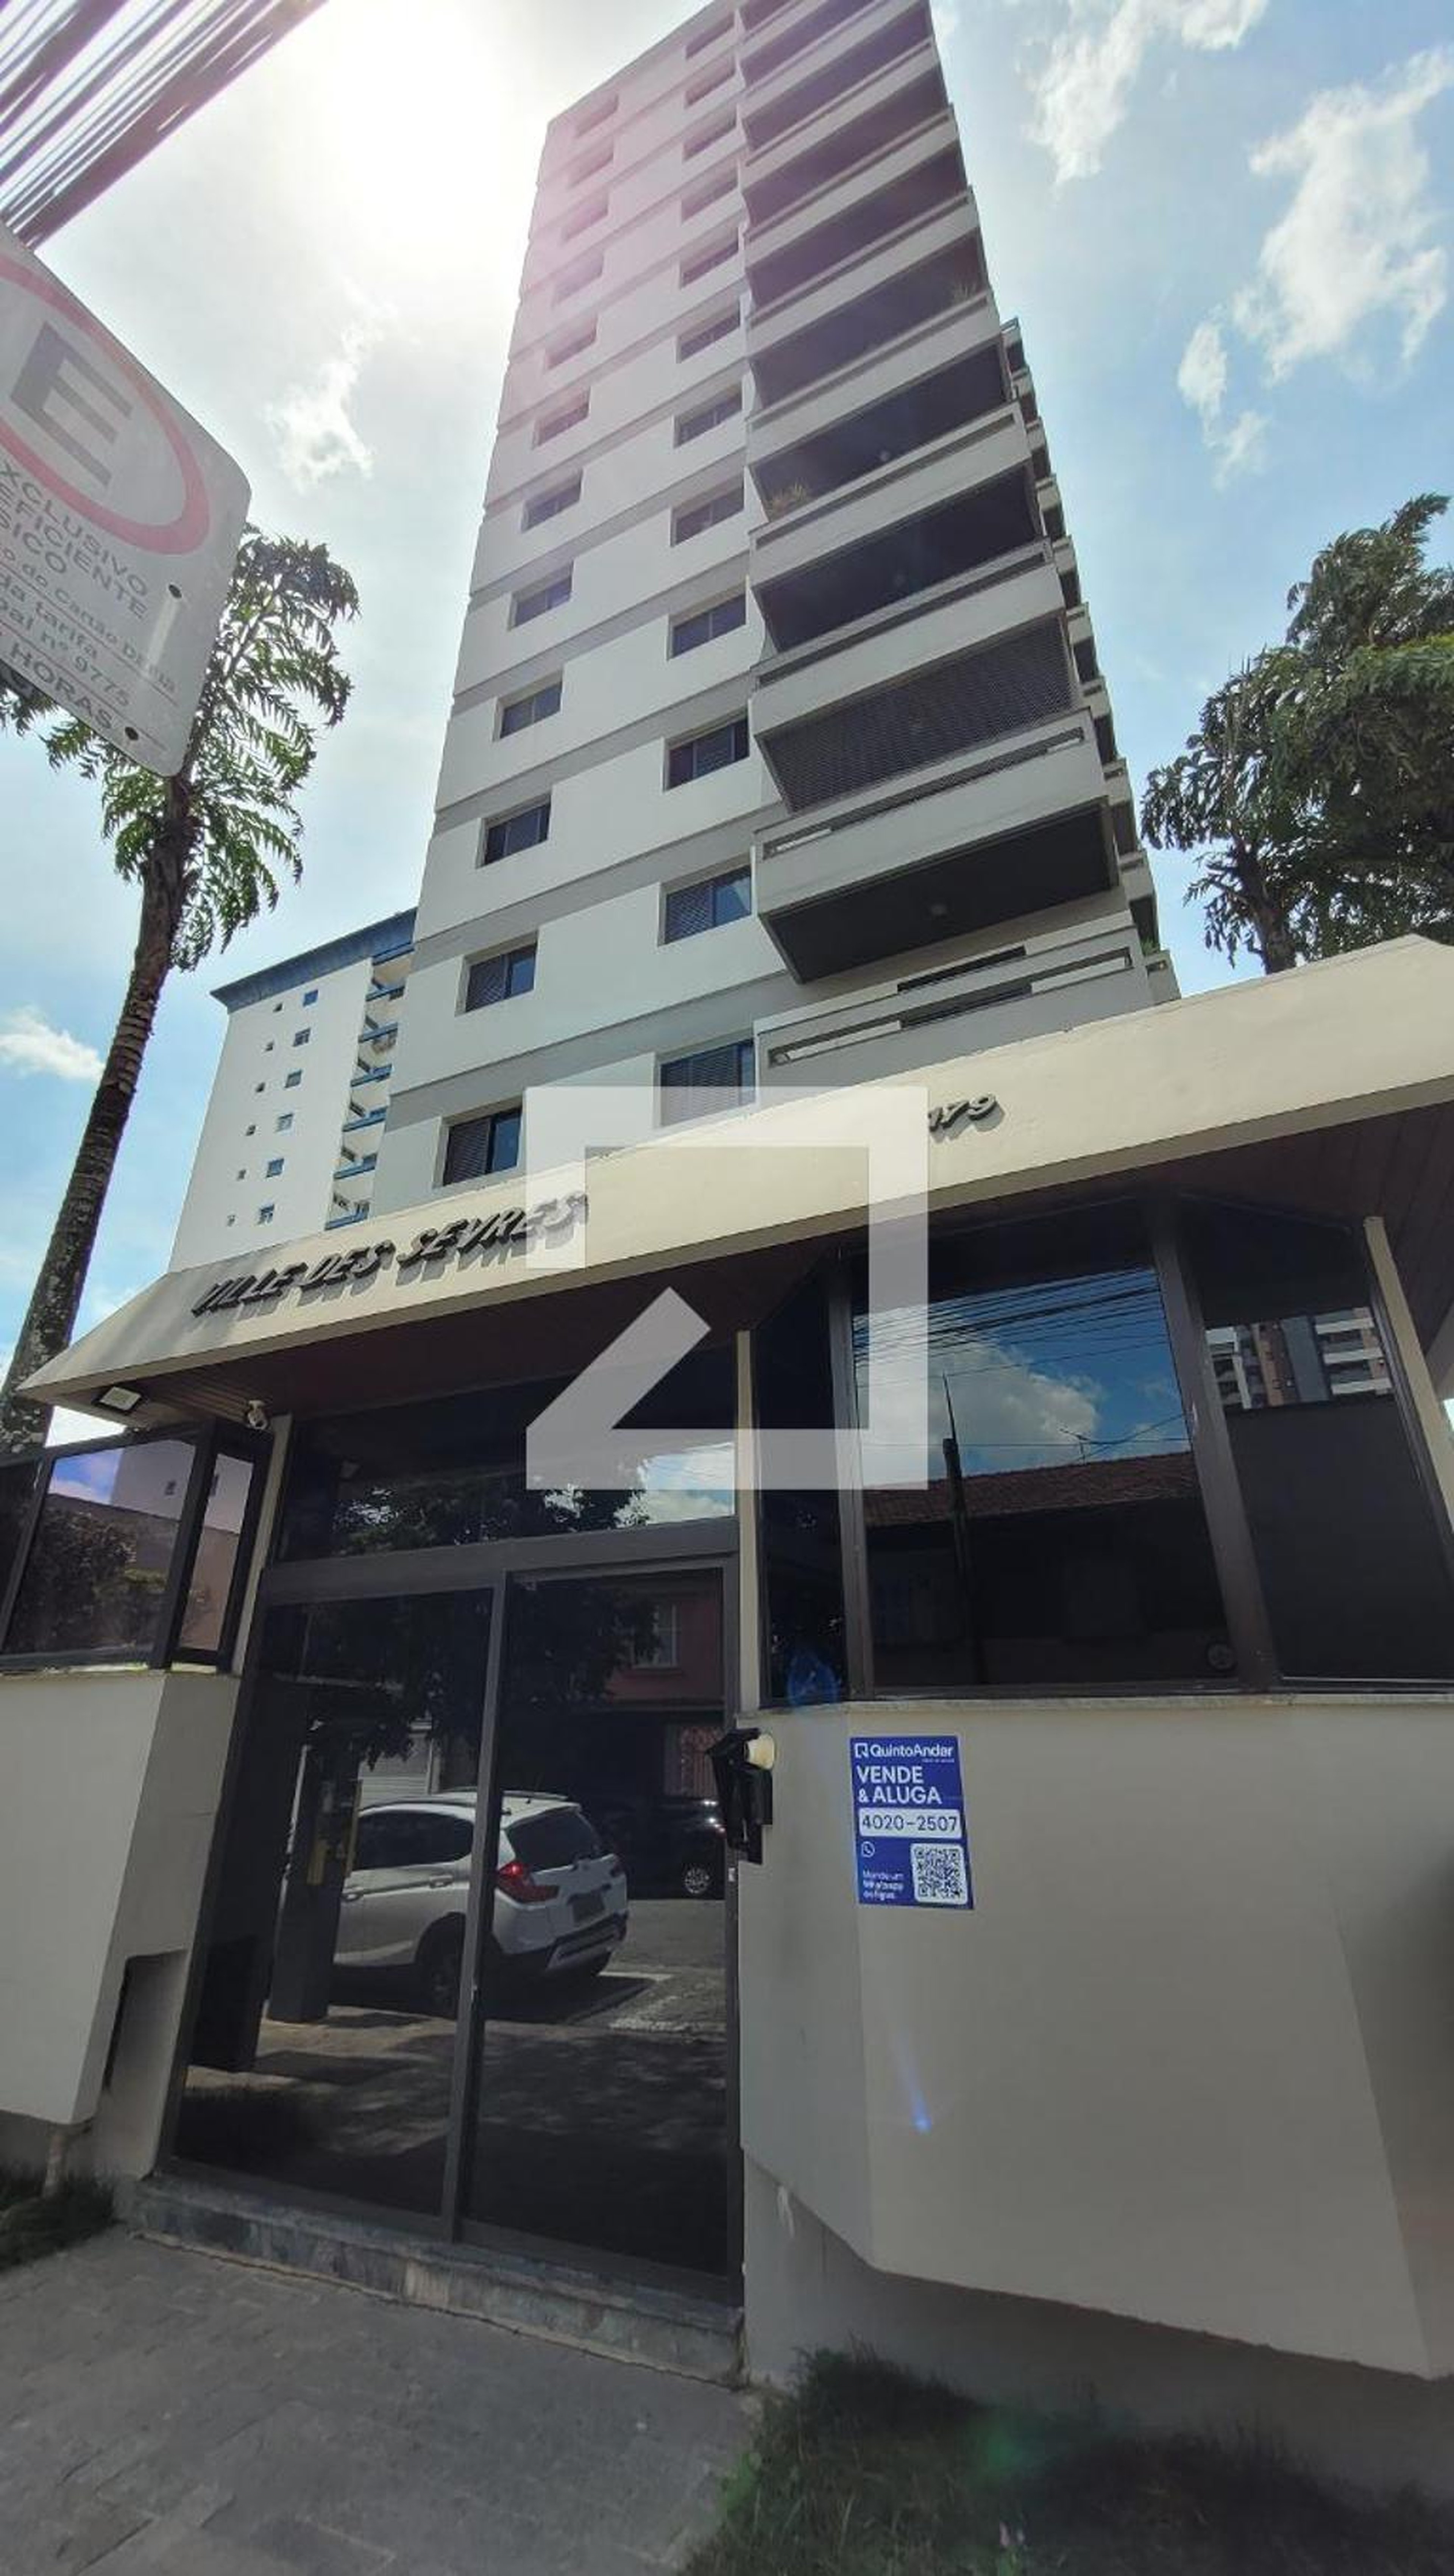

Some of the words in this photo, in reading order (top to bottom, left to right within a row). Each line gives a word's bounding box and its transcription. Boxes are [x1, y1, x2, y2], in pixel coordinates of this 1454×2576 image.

[11, 321, 134, 487] E
[0, 458, 147, 596] XCLUSIVO
[0, 507, 67, 573] SICO
[0, 481, 148, 619] EFICIENTE
[36, 601, 97, 658] tarifa
[9, 642, 113, 730] HORAS
[75, 655, 129, 708] 9775
[191, 1261, 308, 1318] VILLE
[300, 1239, 396, 1292] DES
[856, 1765, 924, 1784] VENDE
[870, 1743, 954, 1757] QuintoAndar
[858, 1788, 869, 1803] &
[872, 1785, 942, 1804] ALUGA
[863, 1815, 957, 1831] 4020-2507
